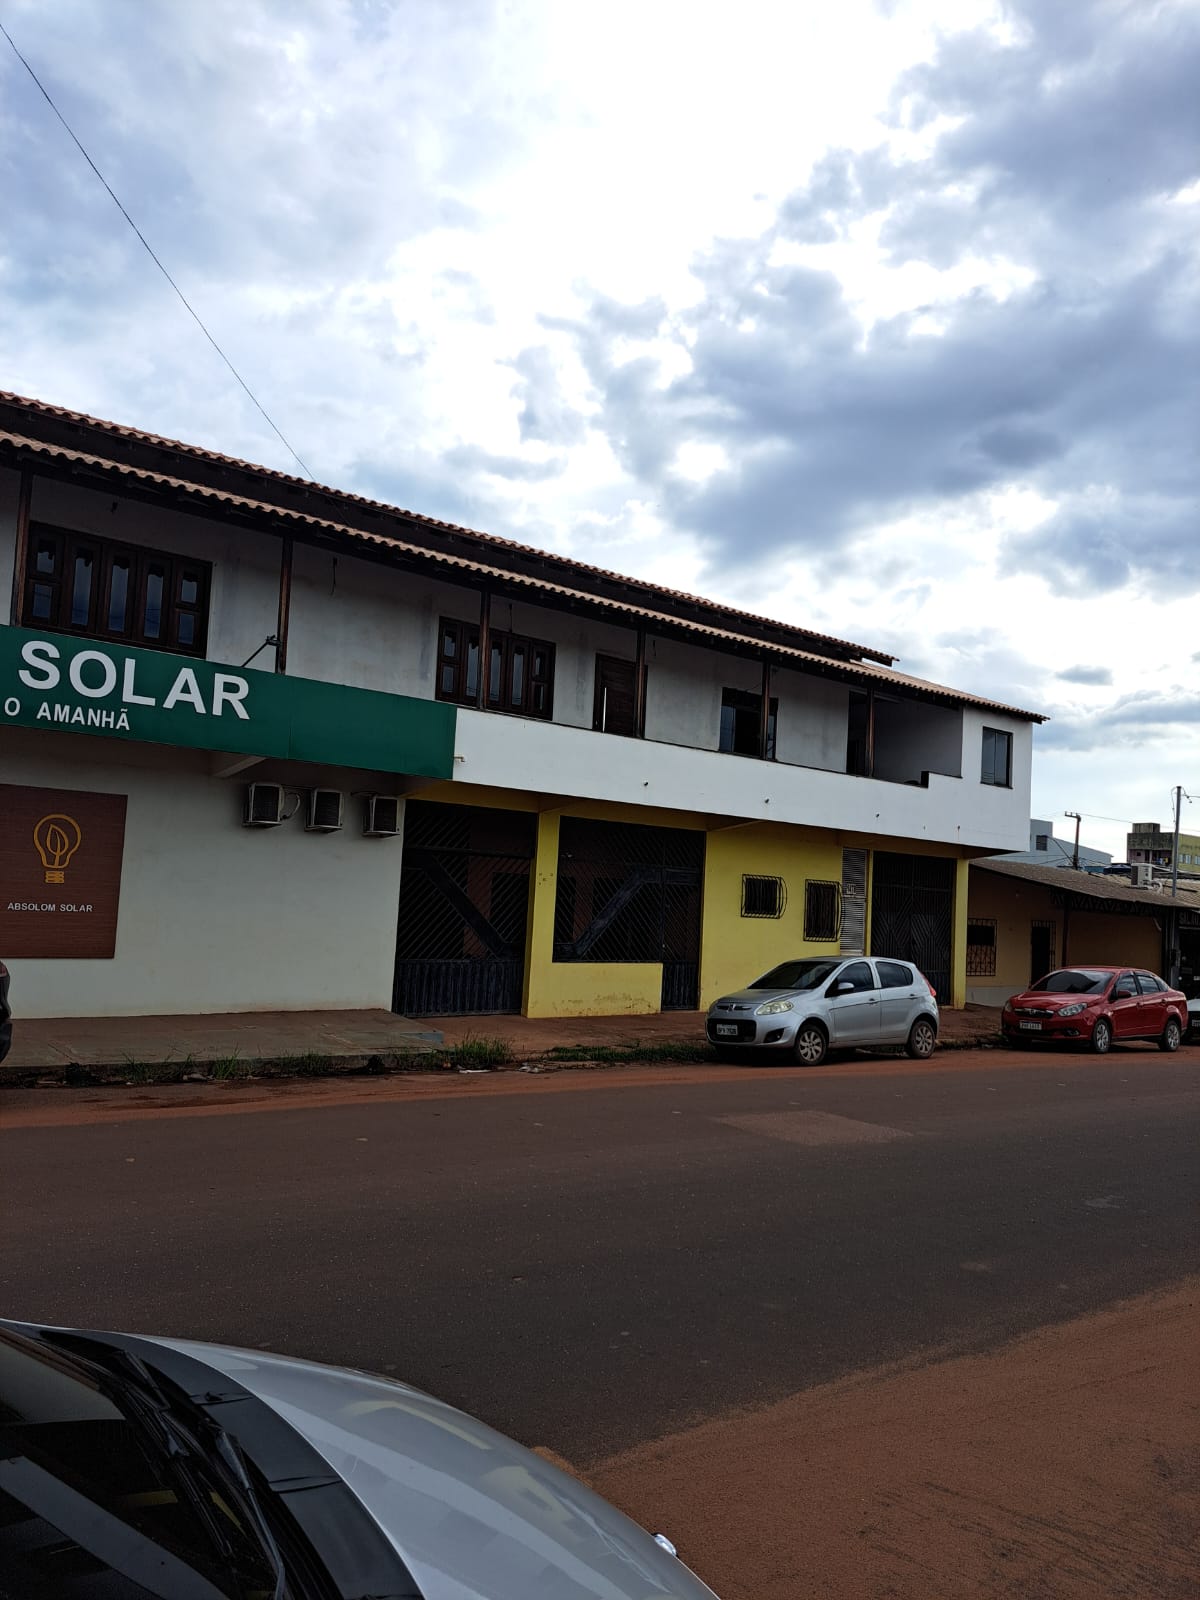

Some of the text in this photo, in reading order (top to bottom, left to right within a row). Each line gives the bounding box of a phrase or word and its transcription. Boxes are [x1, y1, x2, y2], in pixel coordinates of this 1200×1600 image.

[18, 640, 250, 719] SOLAR
[4, 697, 130, 730] O AMANHÃ
[7, 902, 93, 912] ABSOLOM SOLAR
